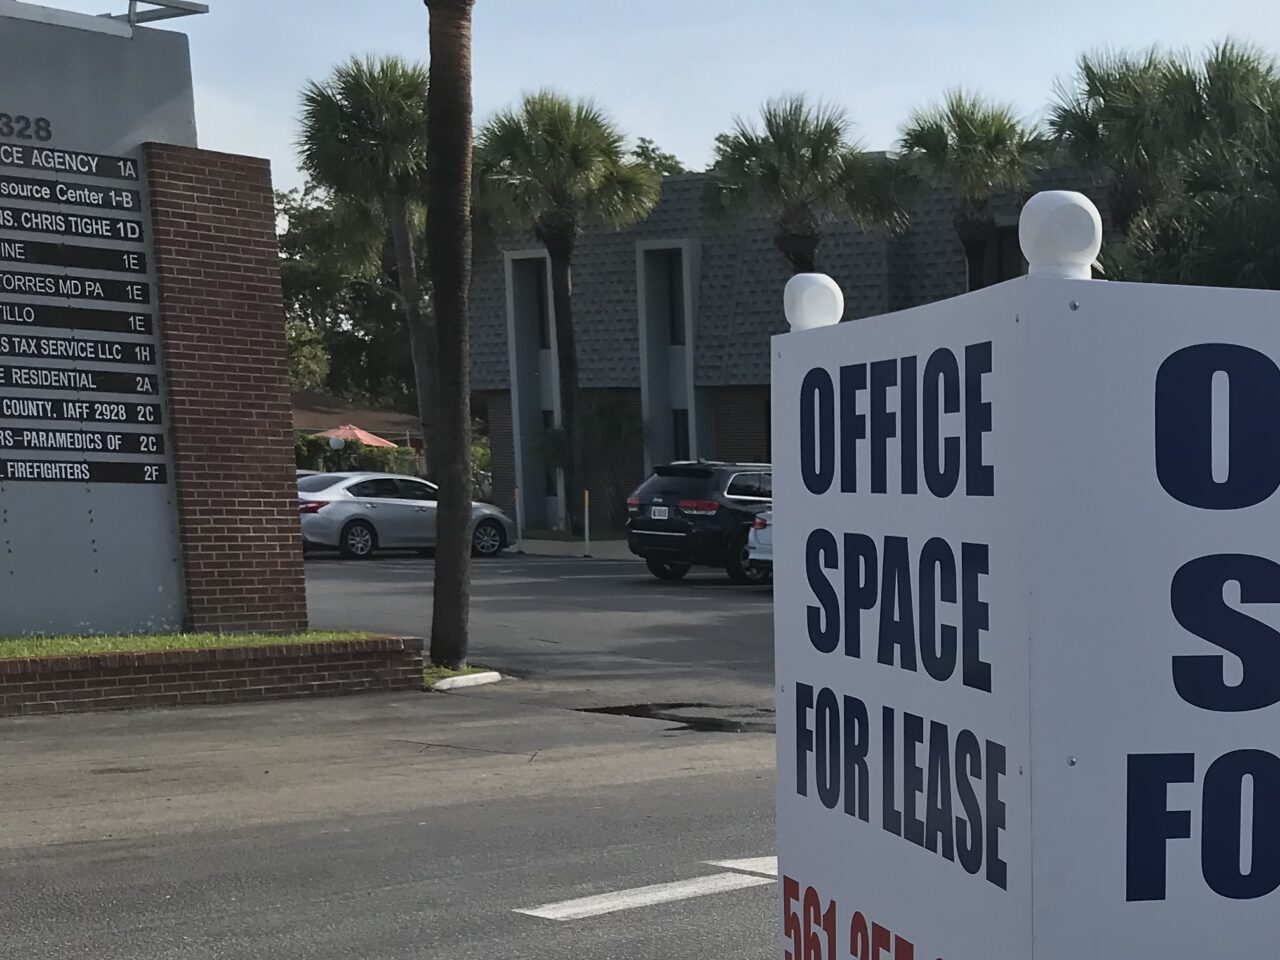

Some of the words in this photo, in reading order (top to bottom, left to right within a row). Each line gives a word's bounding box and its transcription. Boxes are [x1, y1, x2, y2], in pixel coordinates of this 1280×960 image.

[31, 150, 99, 173] AGENCY
[118, 160, 136, 178] 1A
[0, 182, 50, 199] source
[56, 184, 103, 205] Center
[109, 191, 133, 208] 1-B
[21, 212, 65, 231] CHRIS
[68, 217, 112, 236] TIGHE
[117, 222, 140, 238] 1D
[122, 254, 139, 269] 1E
[59, 279, 81, 295] MD
[85, 282, 104, 297] PA
[126, 285, 143, 300] 1E
[129, 316, 145, 331] 1E
[12, 338, 37, 355] TAX
[40, 340, 95, 358] SERVICE
[99, 344, 122, 360] LLC
[135, 346, 150, 361] 1H
[12, 368, 96, 389] RESIDENTIAL
[136, 376, 152, 392] 2A
[63, 402, 90, 419] IAFF
[94, 403, 126, 420] 2928
[137, 405, 154, 421] 2C
[800, 341, 994, 498] OFFICE
[107, 434, 122, 450] OF
[140, 436, 157, 451] 2C
[7, 462, 90, 479] FIREFIGHTERS
[144, 466, 159, 480] 2F
[806, 528, 992, 693] SPACE
[796, 681, 869, 823] FOR
[882, 705, 1007, 891] LEASE
